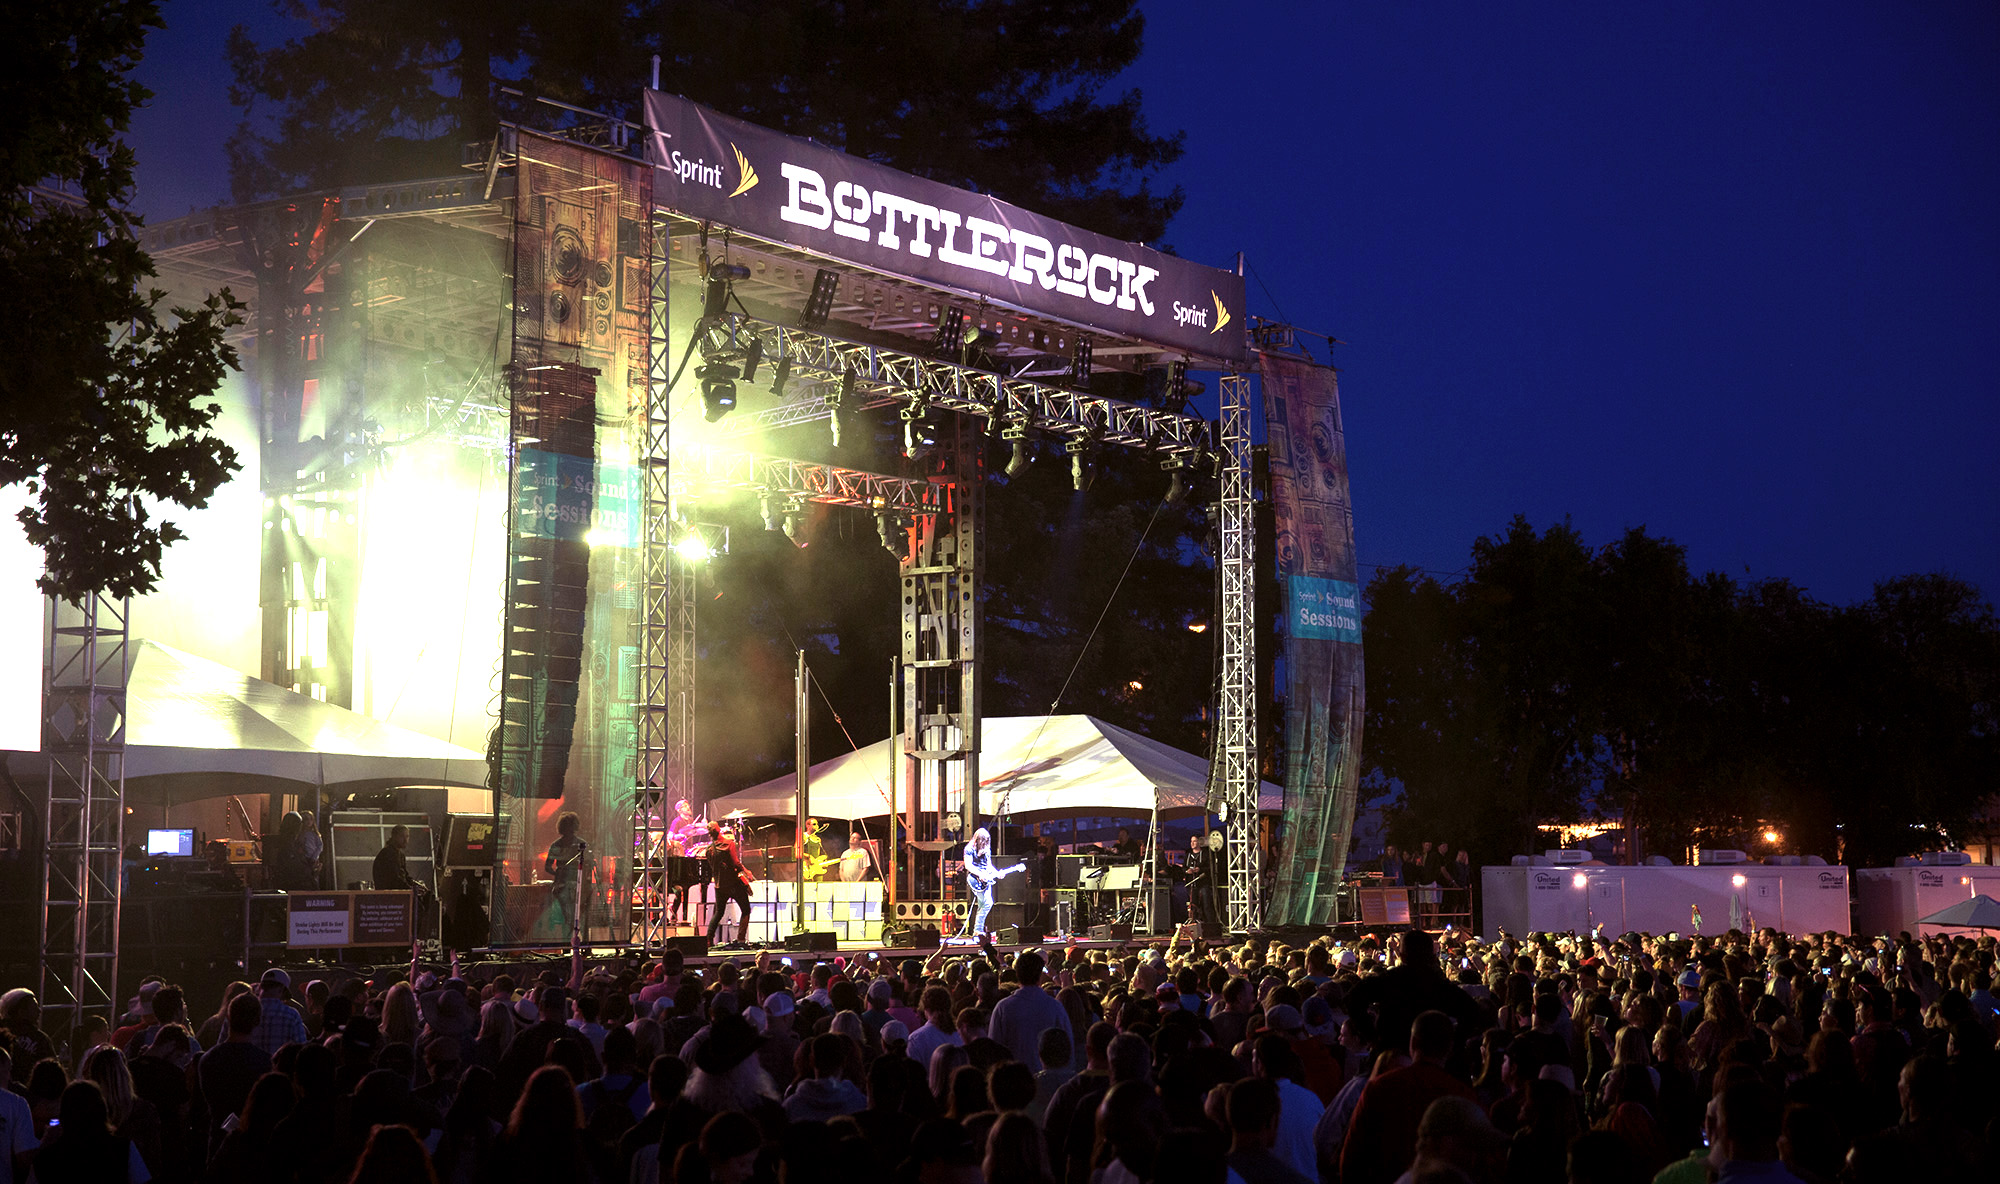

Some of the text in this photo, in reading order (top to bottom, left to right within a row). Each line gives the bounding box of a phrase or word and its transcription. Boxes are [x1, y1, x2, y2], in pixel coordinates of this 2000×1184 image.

[671, 150, 723, 189] Sprint
[1173, 300, 1208, 328] Sprint
[533, 471, 560, 488] Sprint
[532, 495, 628, 530] Sessions
[1298, 591, 1355, 609] Sprint Sound
[1300, 607, 1356, 631] Sessions
[1921, 873, 1944, 881] United
[305, 899, 335, 908] WARNING
